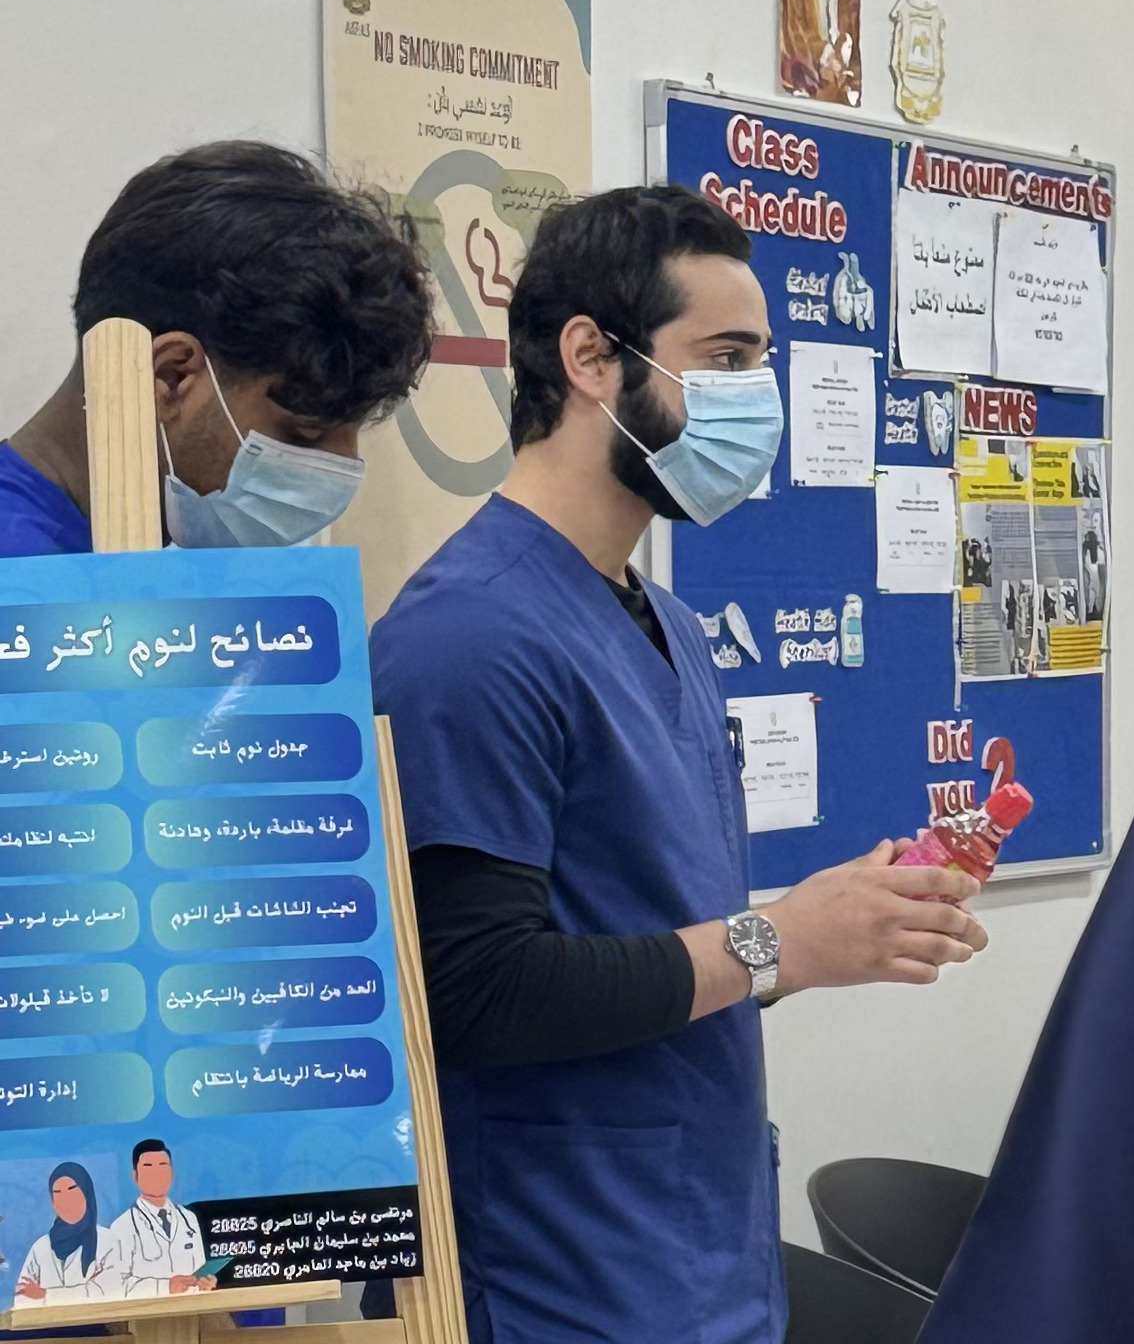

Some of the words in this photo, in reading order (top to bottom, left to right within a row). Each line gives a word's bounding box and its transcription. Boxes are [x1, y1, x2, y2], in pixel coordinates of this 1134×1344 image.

[374, 30, 394, 64] NO
[399, 34, 465, 75] SMOKING
[469, 46, 560, 91] COMMITMENT
[726, 114, 819, 179] Class
[904, 139, 1113, 221] Announcements
[700, 172, 848, 243] Schedule
[960, 384, 1037, 436] NEWS
[46, 614, 113, 671] أكثر
[128, 623, 197, 677] لنوم
[210, 619, 313, 668] نصائح
[191, 739, 231, 759] ثابت
[236, 741, 263, 763] نوم
[268, 739, 309, 759] جدول
[927, 719, 974, 763] Did
[53, 749, 99, 767] روتين
[52, 909, 80, 927] على
[85, 906, 126, 926] احصل
[170, 904, 209, 931] النوم
[213, 901, 242, 925] قبل
[246, 900, 311, 918] الشاشات
[316, 900, 357, 919] تجنب
[100, 987, 109, 1003] لا
[251, 981, 315, 1005] الكافيين
[319, 984, 342, 1001] من
[346, 979, 377, 996] الحد
[192, 1069, 249, 1098] بانتظام
[253, 1065, 310, 1088] الرياضة
[313, 1063, 367, 1084] ممارسة
[38, 1080, 77, 1103] إدارة
[315, 1210, 346, 1232] سالم
